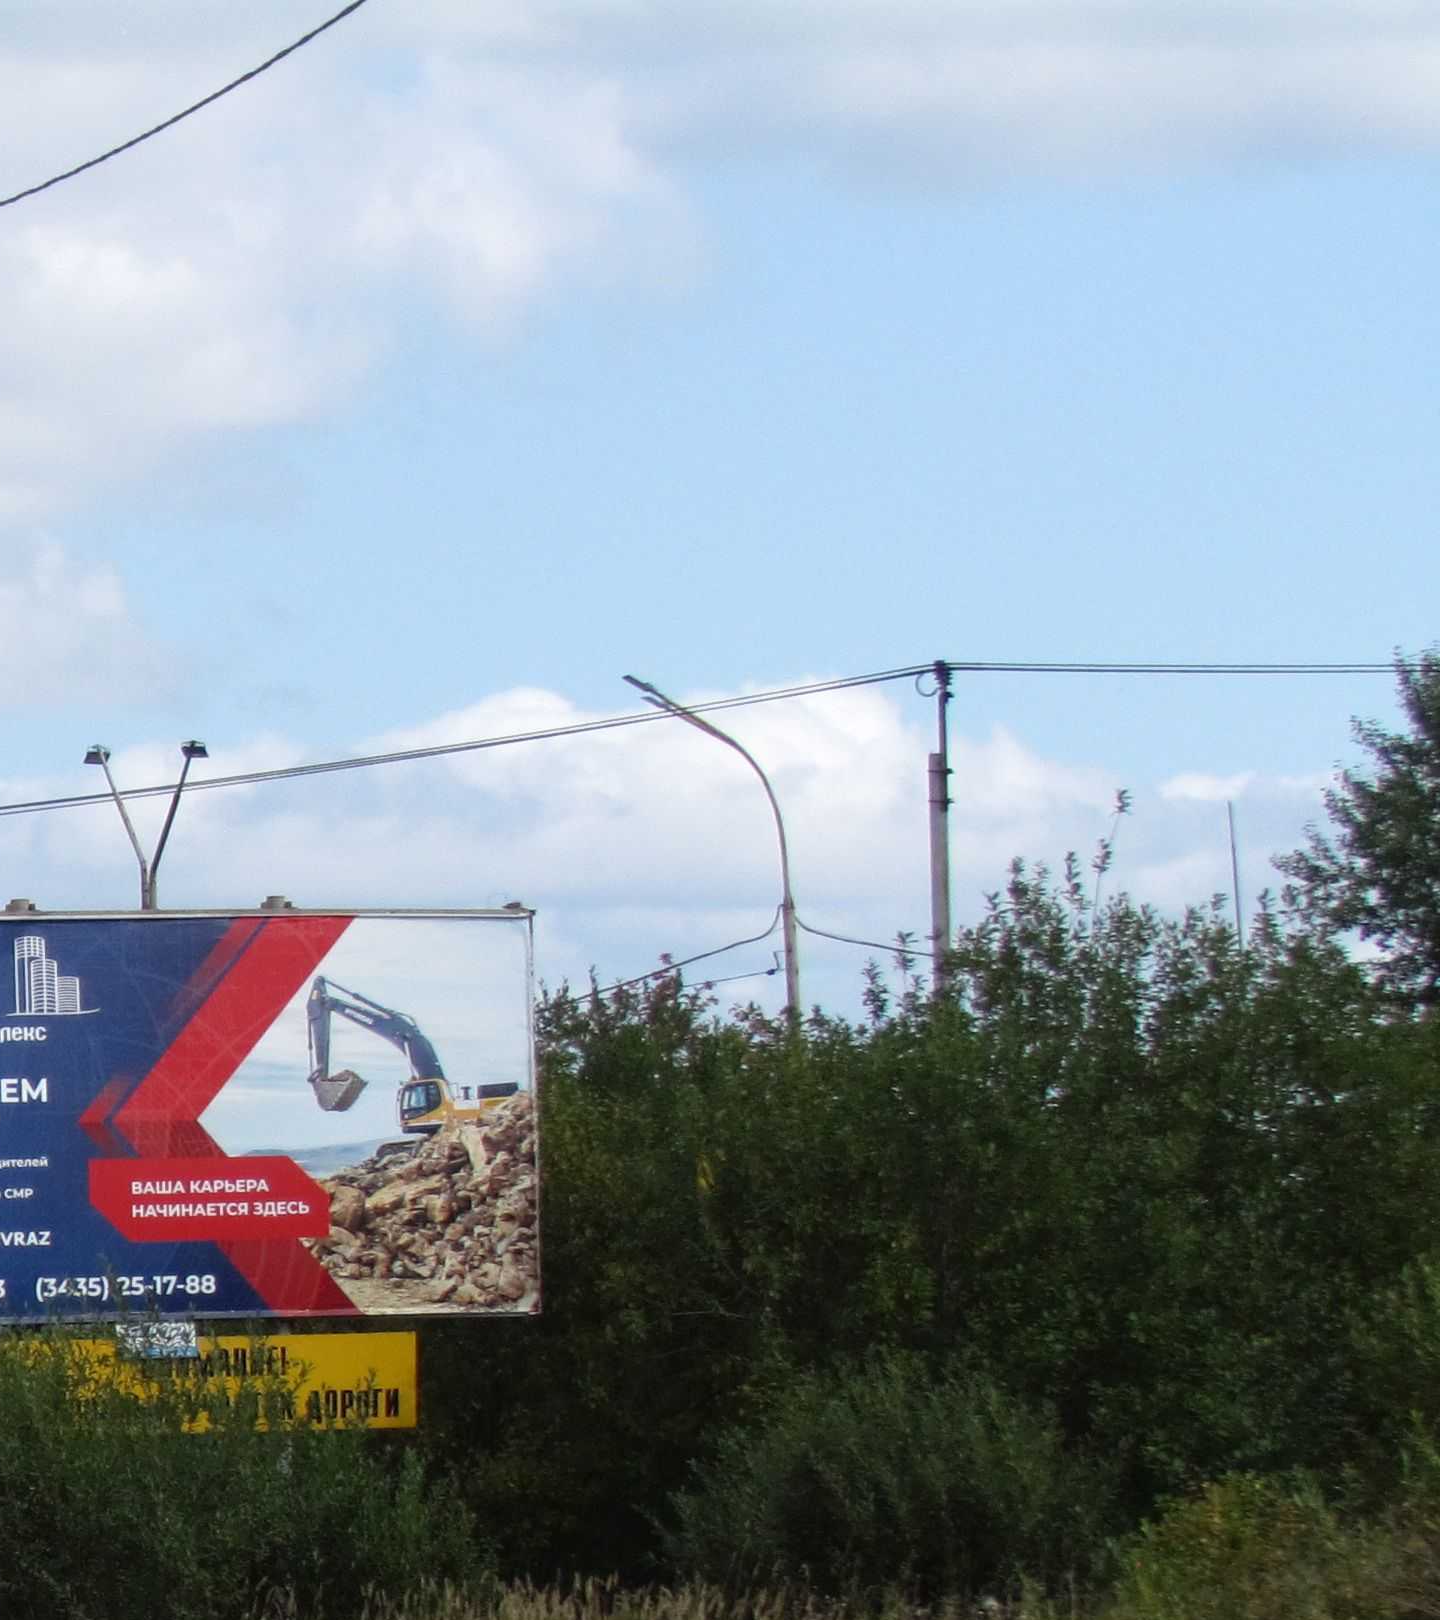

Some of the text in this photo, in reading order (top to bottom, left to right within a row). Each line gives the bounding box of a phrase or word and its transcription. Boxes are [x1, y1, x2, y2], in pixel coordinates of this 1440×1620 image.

[4, 1187, 34, 1199] СМР
[132, 1178, 270, 1195] ВАША КАРЬЕРА
[132, 1200, 310, 1218] НАЧИНАЕТСЯ ЗДЕСЬ
